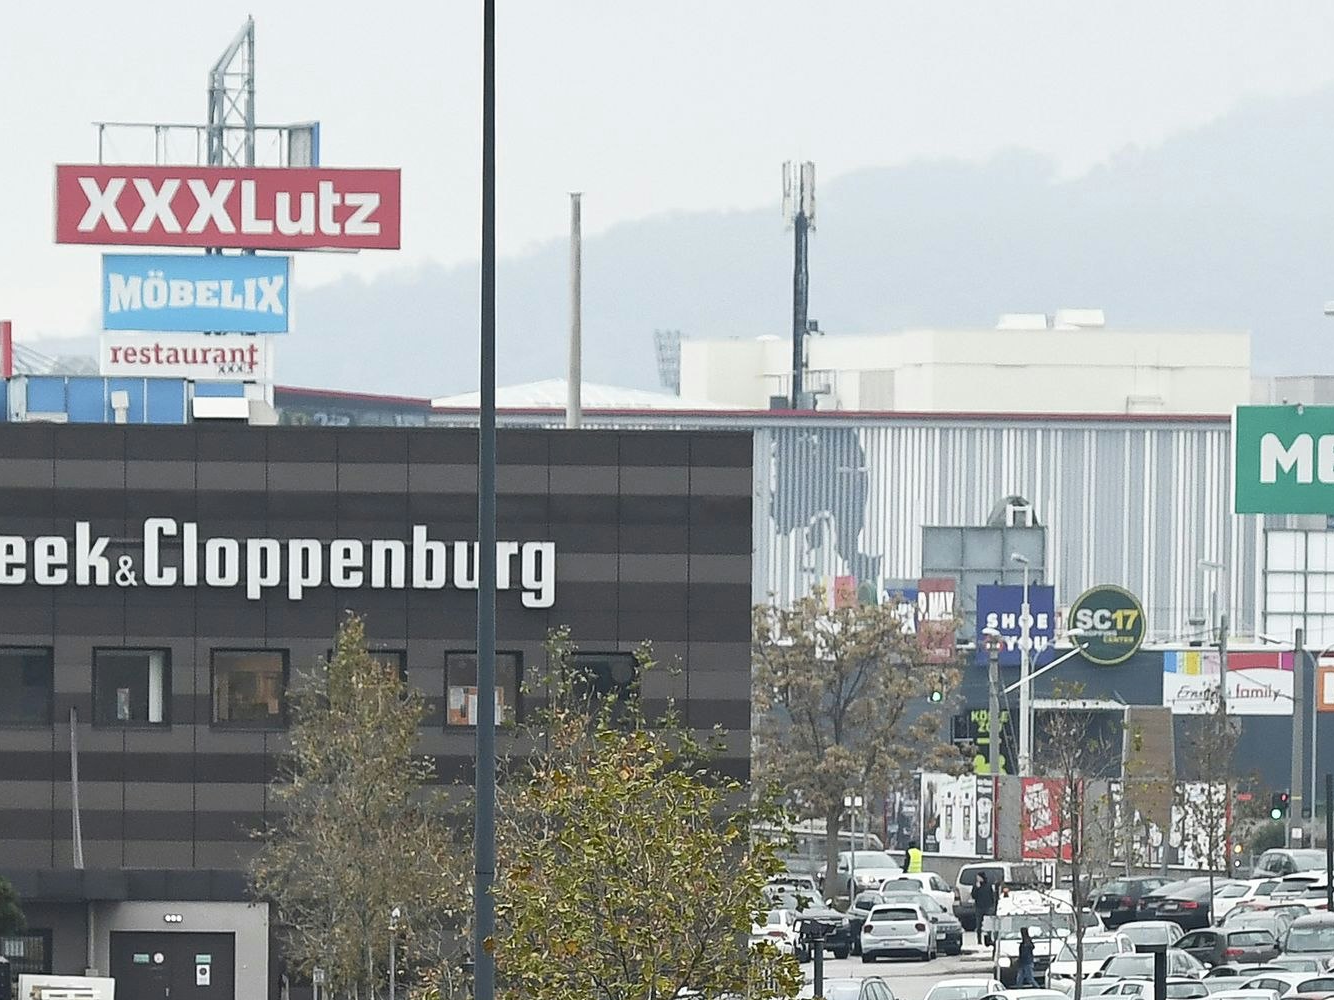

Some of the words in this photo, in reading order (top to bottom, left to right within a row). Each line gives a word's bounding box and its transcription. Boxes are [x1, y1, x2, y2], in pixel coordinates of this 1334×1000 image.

[77, 176, 381, 237] XXXLutz
[108, 269, 284, 316] MÖBELIX
[110, 342, 259, 372] restaurant
[986, 613, 1049, 630] SHOE
[1076, 608, 1139, 630] SC17
